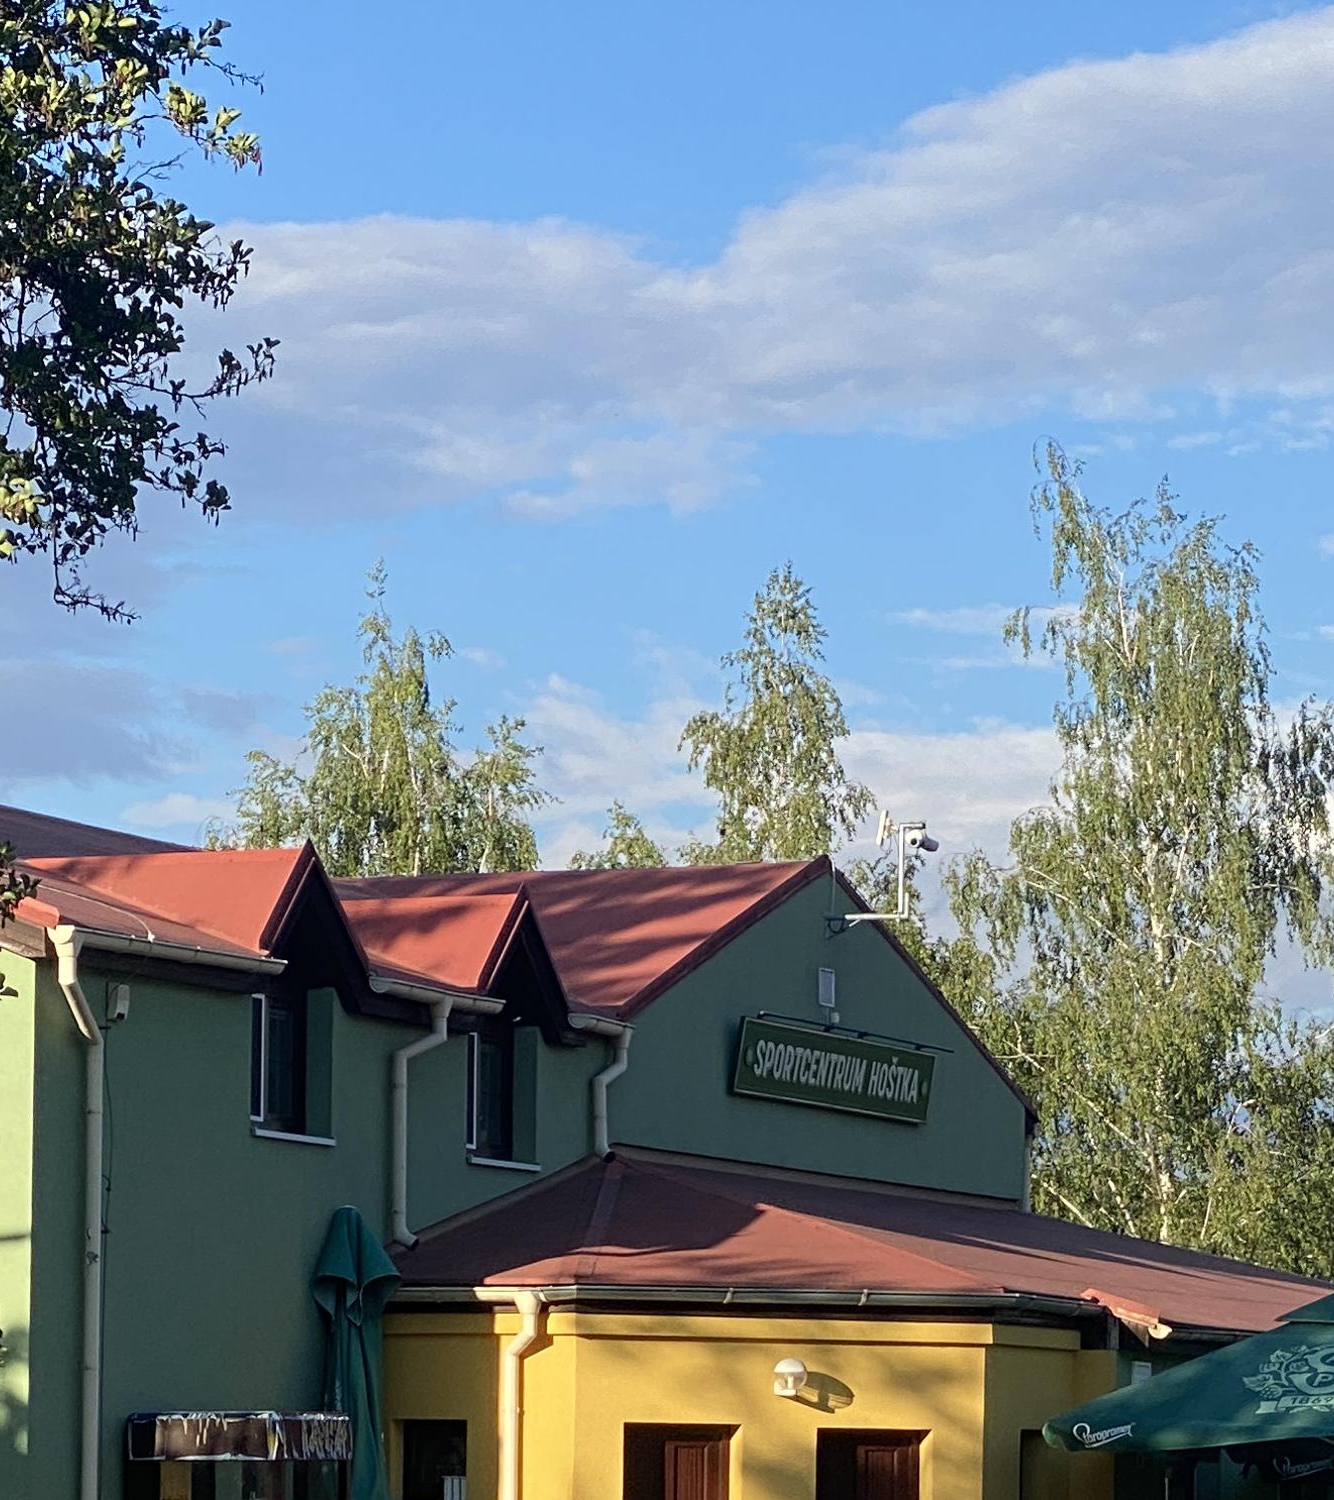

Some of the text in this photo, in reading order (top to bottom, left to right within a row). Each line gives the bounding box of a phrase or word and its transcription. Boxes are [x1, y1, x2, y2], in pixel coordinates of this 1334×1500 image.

[754, 1039, 919, 1103] SPORTCENTRUM HOŠTKA
[1290, 1396, 1334, 1406] 1869
